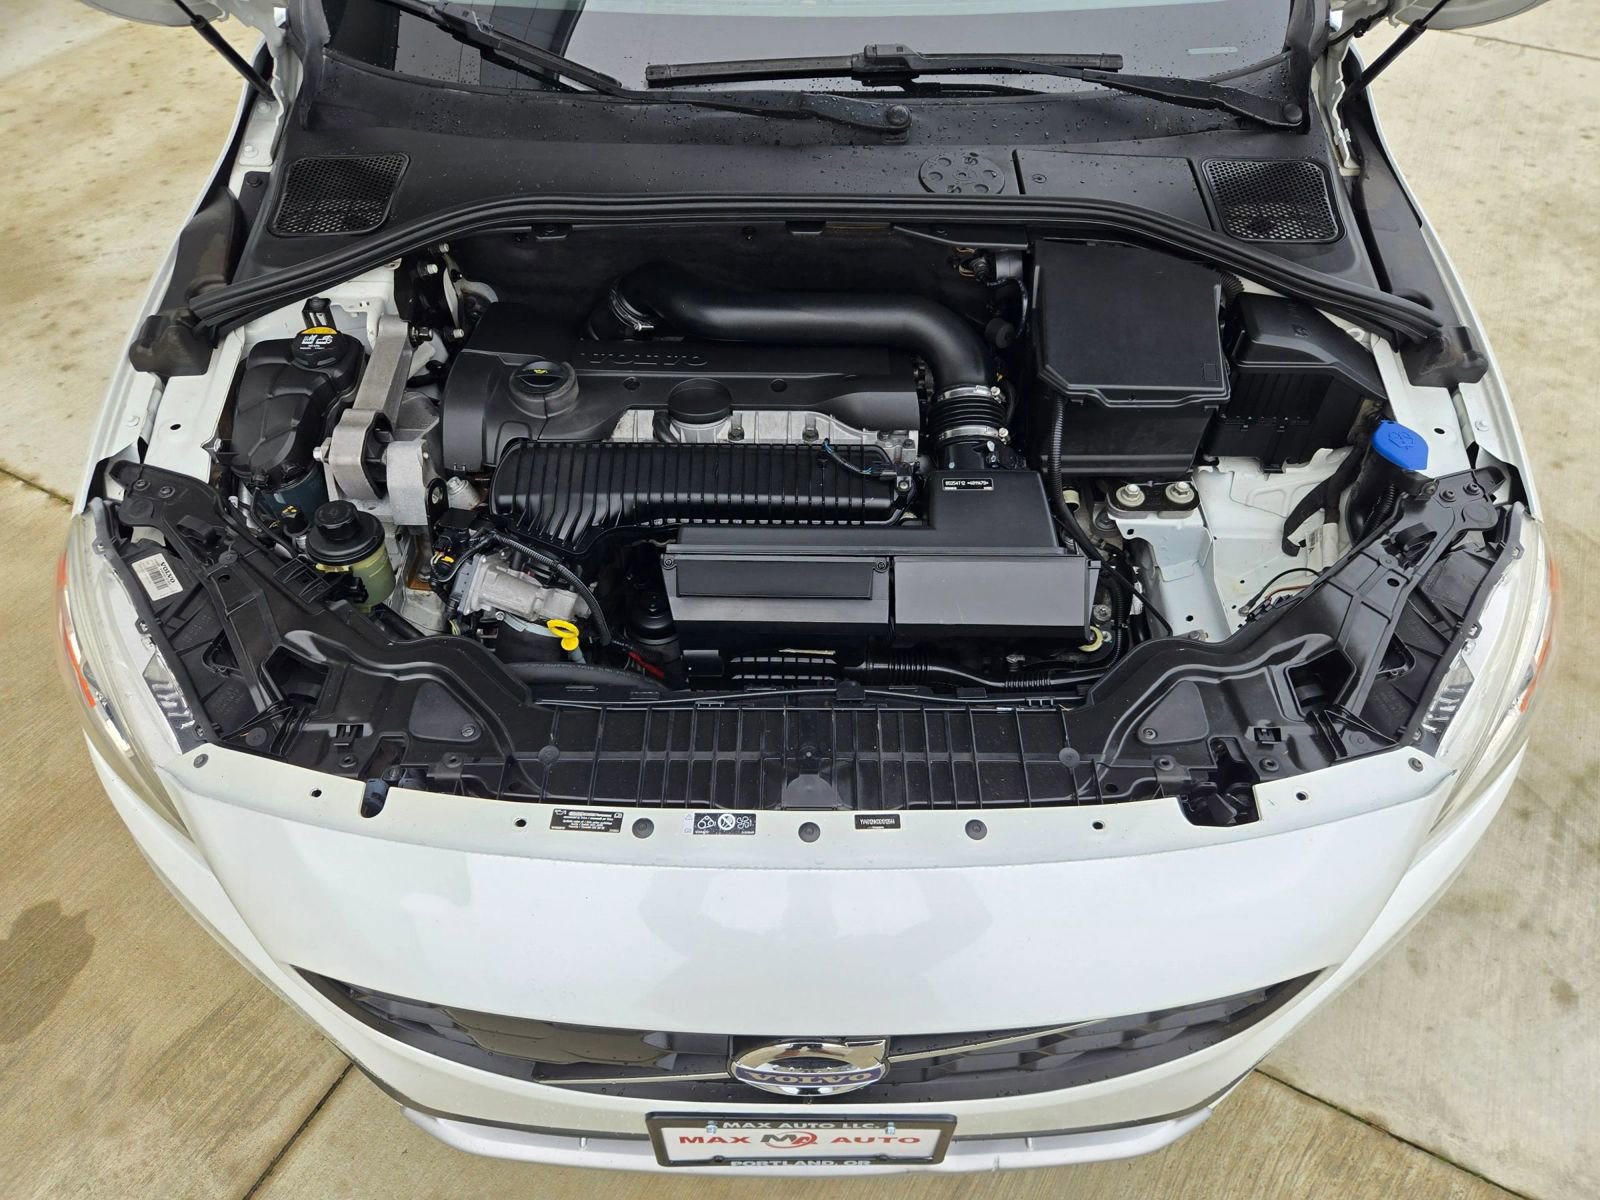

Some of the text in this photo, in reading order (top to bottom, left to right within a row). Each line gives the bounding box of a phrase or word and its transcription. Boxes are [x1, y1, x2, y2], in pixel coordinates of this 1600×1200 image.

[579, 352, 709, 367] VOLVO
[160, 561, 175, 584] VOLVO
[744, 1071, 873, 1084] VOLVO
[842, 1122, 881, 1130] LLC.
[678, 1136, 751, 1144] MAX
[830, 1136, 922, 1144] AUTO
